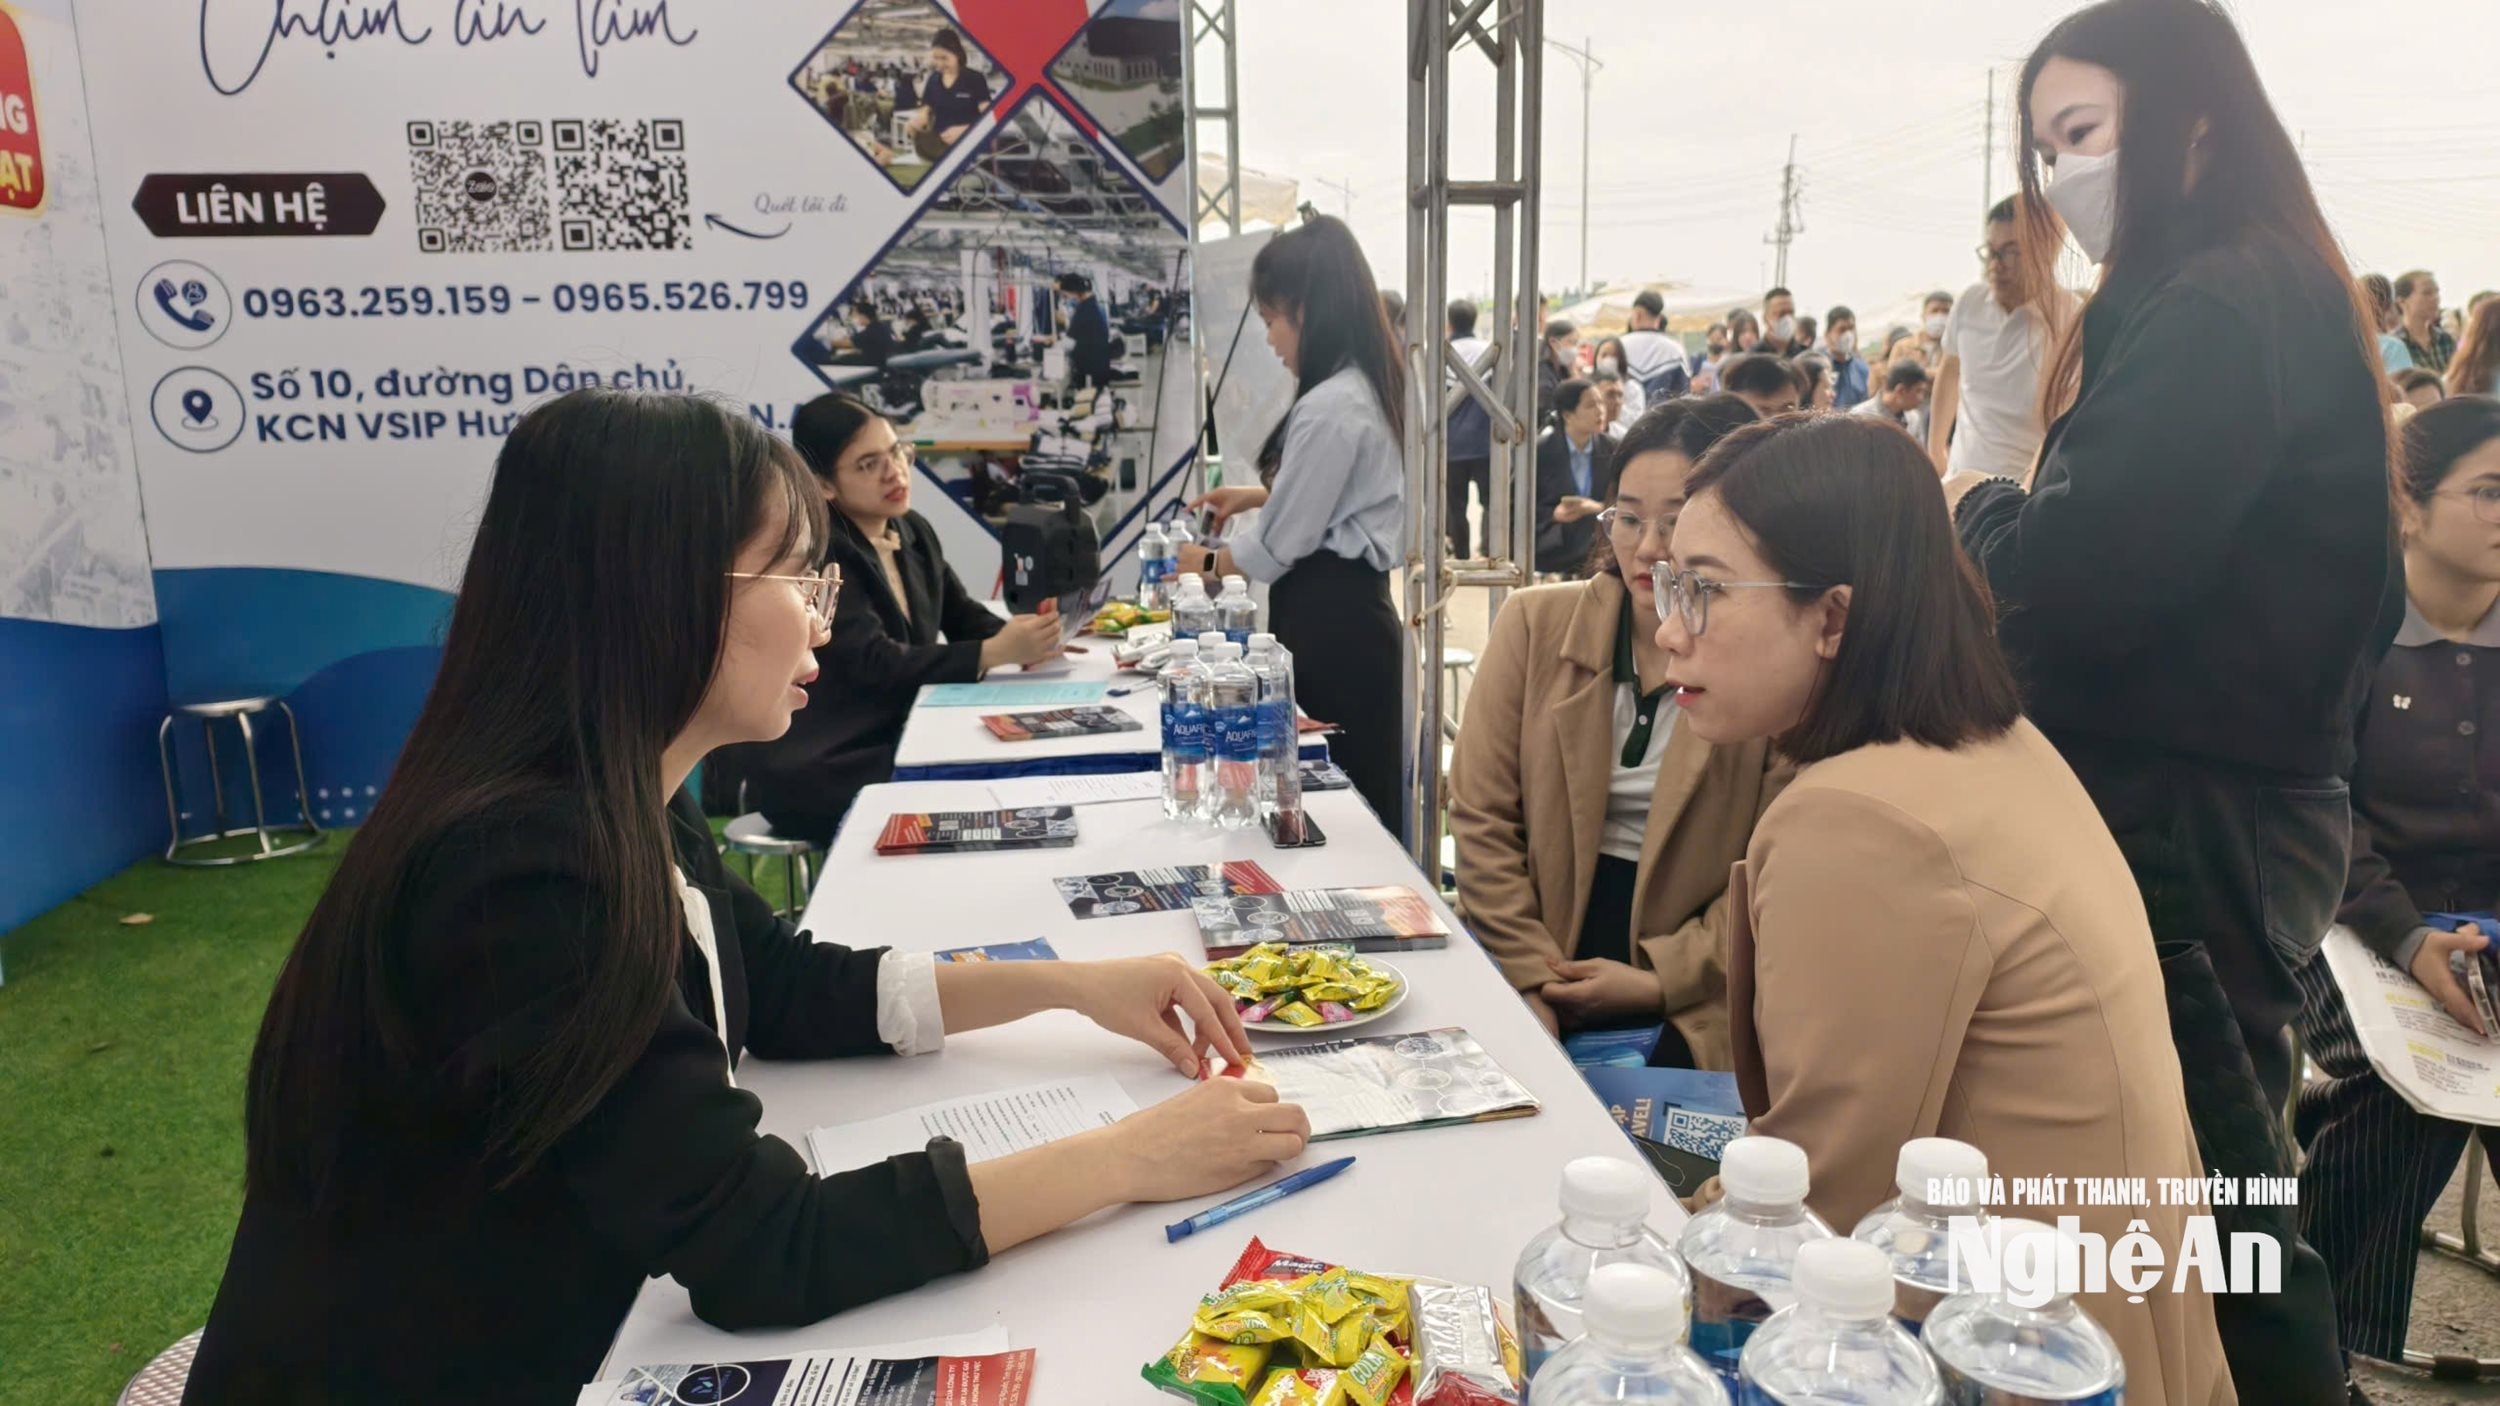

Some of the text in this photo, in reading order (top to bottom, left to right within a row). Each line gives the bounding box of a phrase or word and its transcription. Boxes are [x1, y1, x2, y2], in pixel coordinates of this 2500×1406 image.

[0, 91, 29, 135] G
[176, 182, 328, 231] LIÊN HỆ
[243, 285, 511, 318] 0963.259.159
[553, 281, 808, 312] 0965.526.799
[251, 366, 301, 400] Số
[310, 369, 364, 403] 10,
[375, 366, 513, 404] đường
[523, 363, 601, 394] Dân
[256, 413, 347, 443] KCN
[356, 411, 447, 440] VSIP
